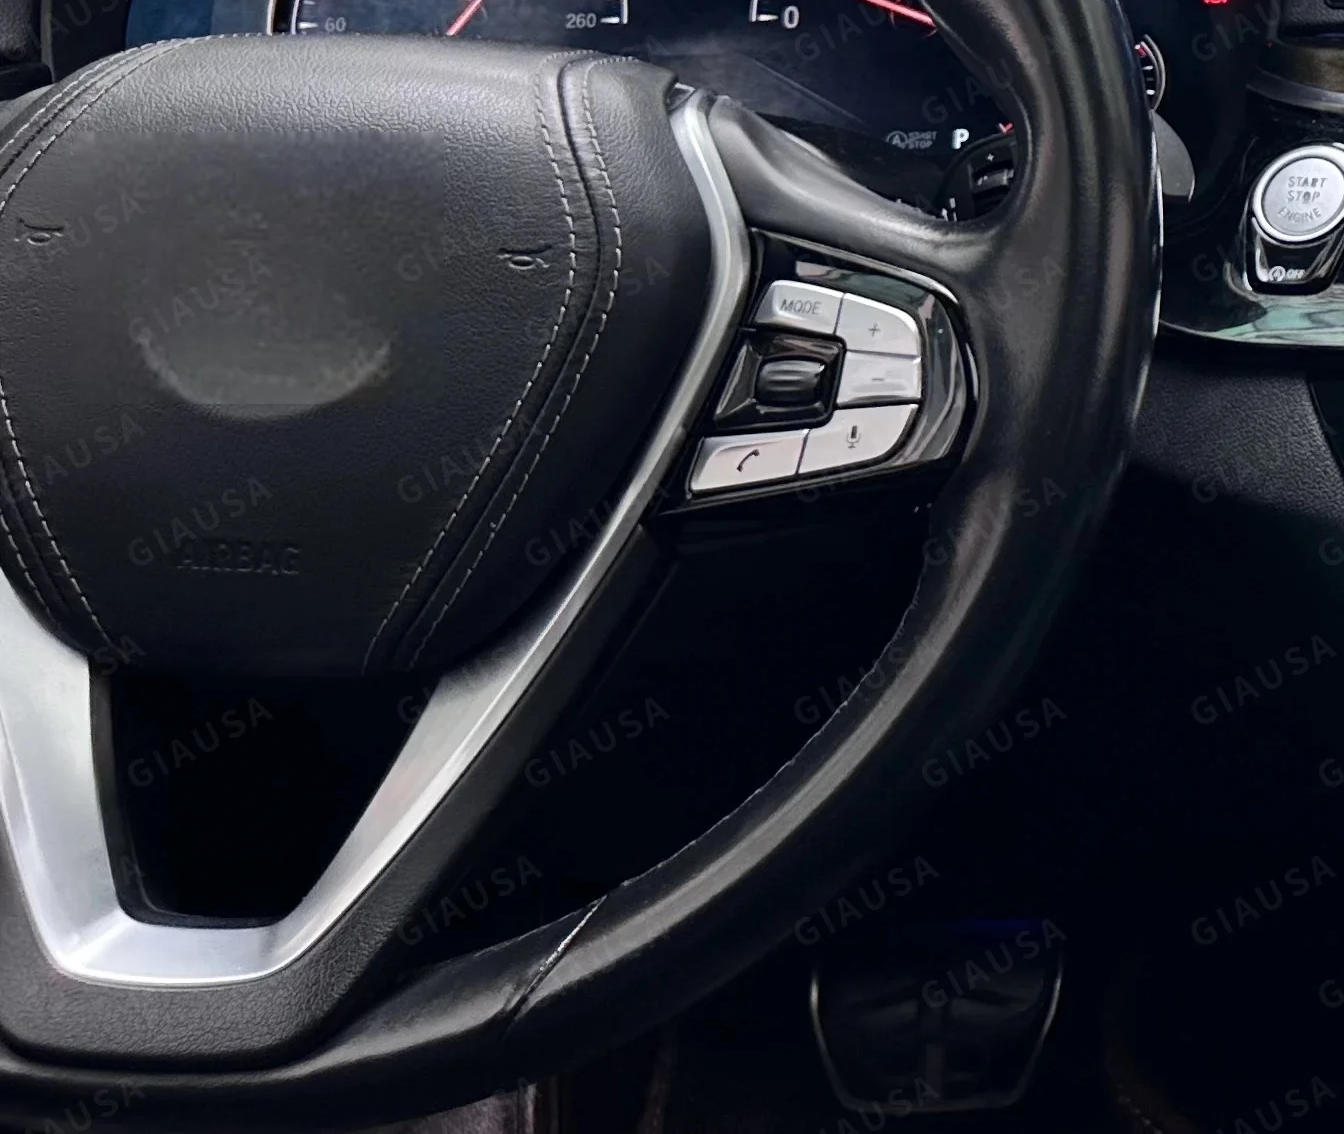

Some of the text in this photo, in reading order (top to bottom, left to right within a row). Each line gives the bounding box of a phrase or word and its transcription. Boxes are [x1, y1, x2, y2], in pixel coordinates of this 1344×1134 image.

[324, 16, 347, 32] 60
[565, 13, 597, 29] 260
[783, 5, 800, 29] 0
[907, 140, 933, 149] STOP
[952, 128, 970, 149] P
[1287, 175, 1329, 188] START
[1287, 190, 1321, 204] STOP
[1277, 206, 1322, 223] ENGINE
[779, 298, 821, 315] MODE
